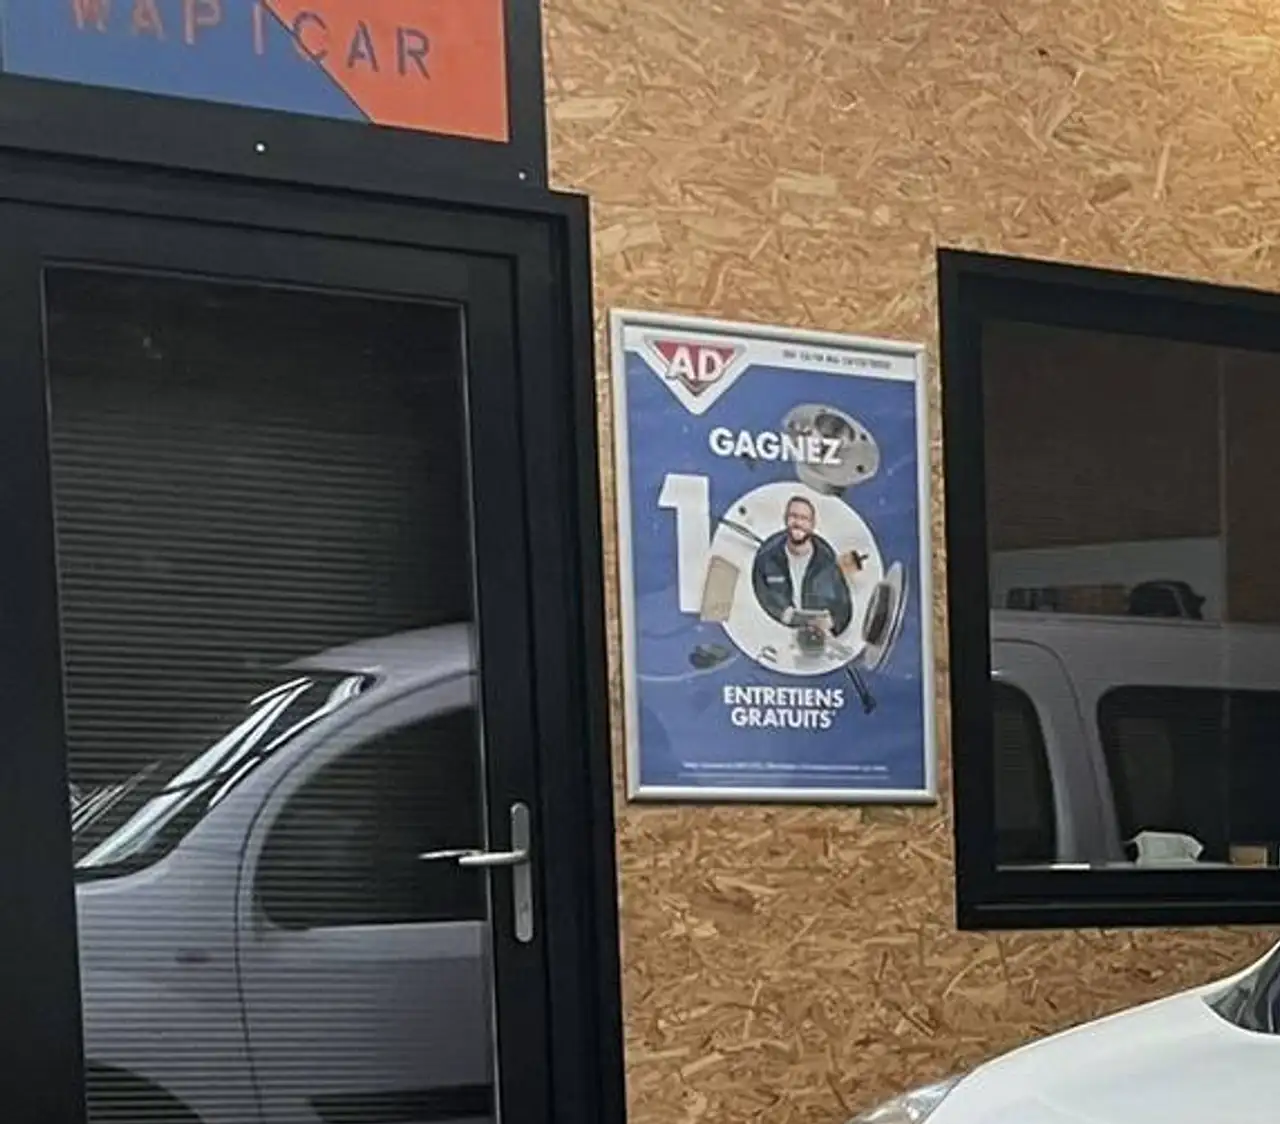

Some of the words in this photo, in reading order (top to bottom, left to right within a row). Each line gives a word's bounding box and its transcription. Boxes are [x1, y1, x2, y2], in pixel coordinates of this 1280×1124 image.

[664, 346, 725, 382] AD
[708, 427, 843, 465] GAGNEZ
[723, 686, 845, 709] ENTRETIENS
